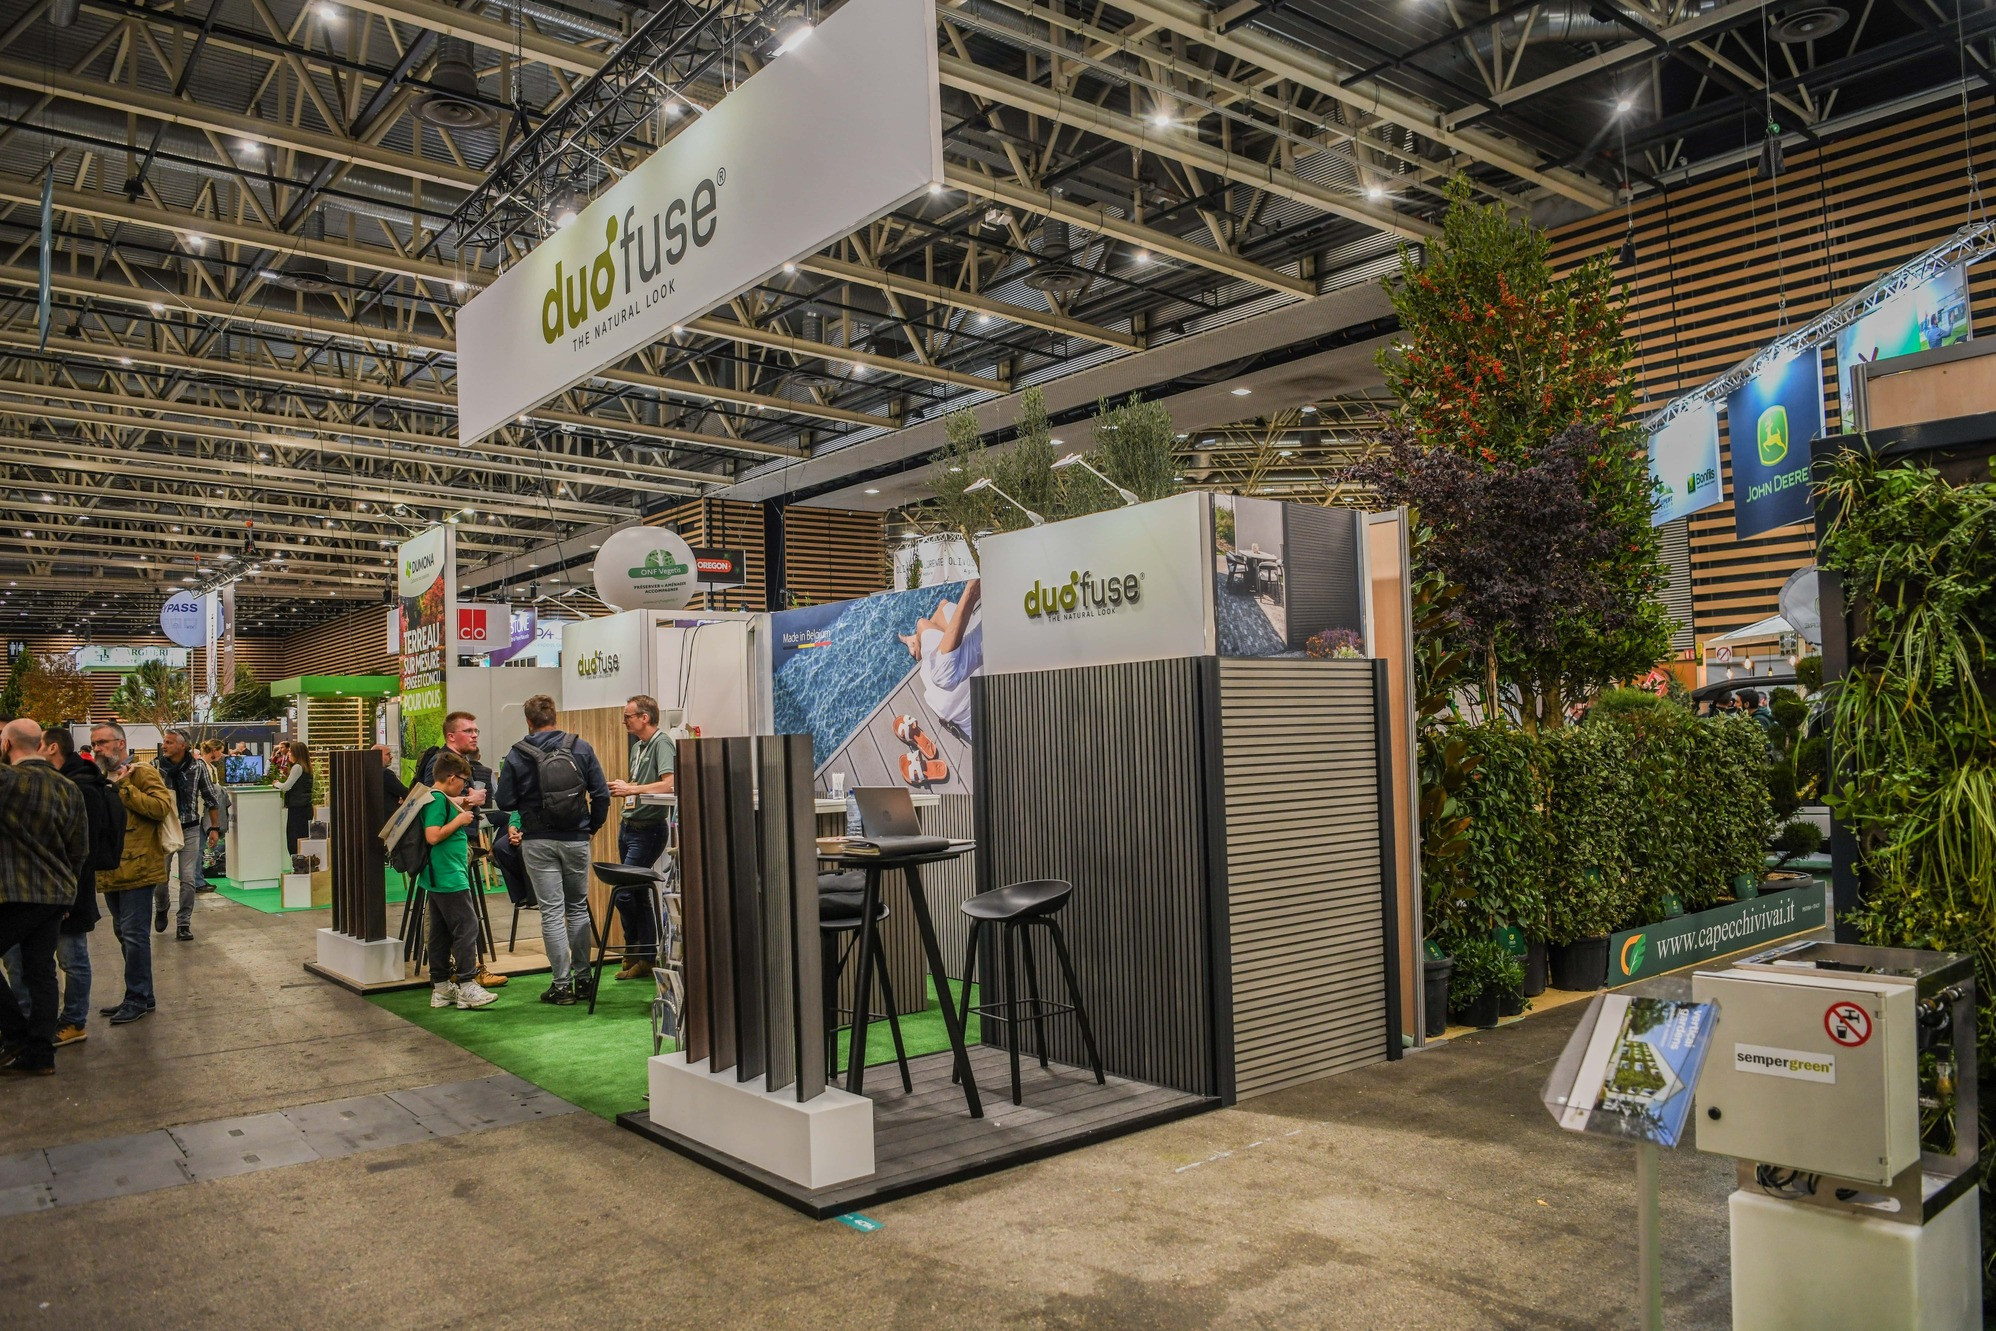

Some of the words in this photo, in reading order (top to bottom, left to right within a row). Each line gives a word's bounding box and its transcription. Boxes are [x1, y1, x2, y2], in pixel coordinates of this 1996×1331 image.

[572, 331, 590, 352] THE
[594, 301, 641, 340] NATURAL
[646, 278, 676, 308] LOOK
[1746, 480, 1772, 503] JOHN
[1773, 467, 1809, 493] DEERE
[411, 552, 435, 574] DUMONA
[640, 568, 657, 576] ONF
[697, 561, 728, 570] OREGON
[1063, 611, 1094, 621] NATURAL
[1097, 607, 1116, 616] LOOK
[403, 622, 440, 655] TERREAU
[783, 632, 799, 644] Made
[800, 631, 806, 642] in
[806, 629, 831, 643] Belgium
[403, 656, 417, 675] SUR
[416, 650, 440, 672] MESURE
[403, 692, 421, 712] POUR
[421, 688, 441, 709] VOUS
[1656, 897, 1796, 960] www.capecchivivai.it
[1668, 1007, 1690, 1051] gardens
[1737, 1051, 1831, 1074] sempergreen
